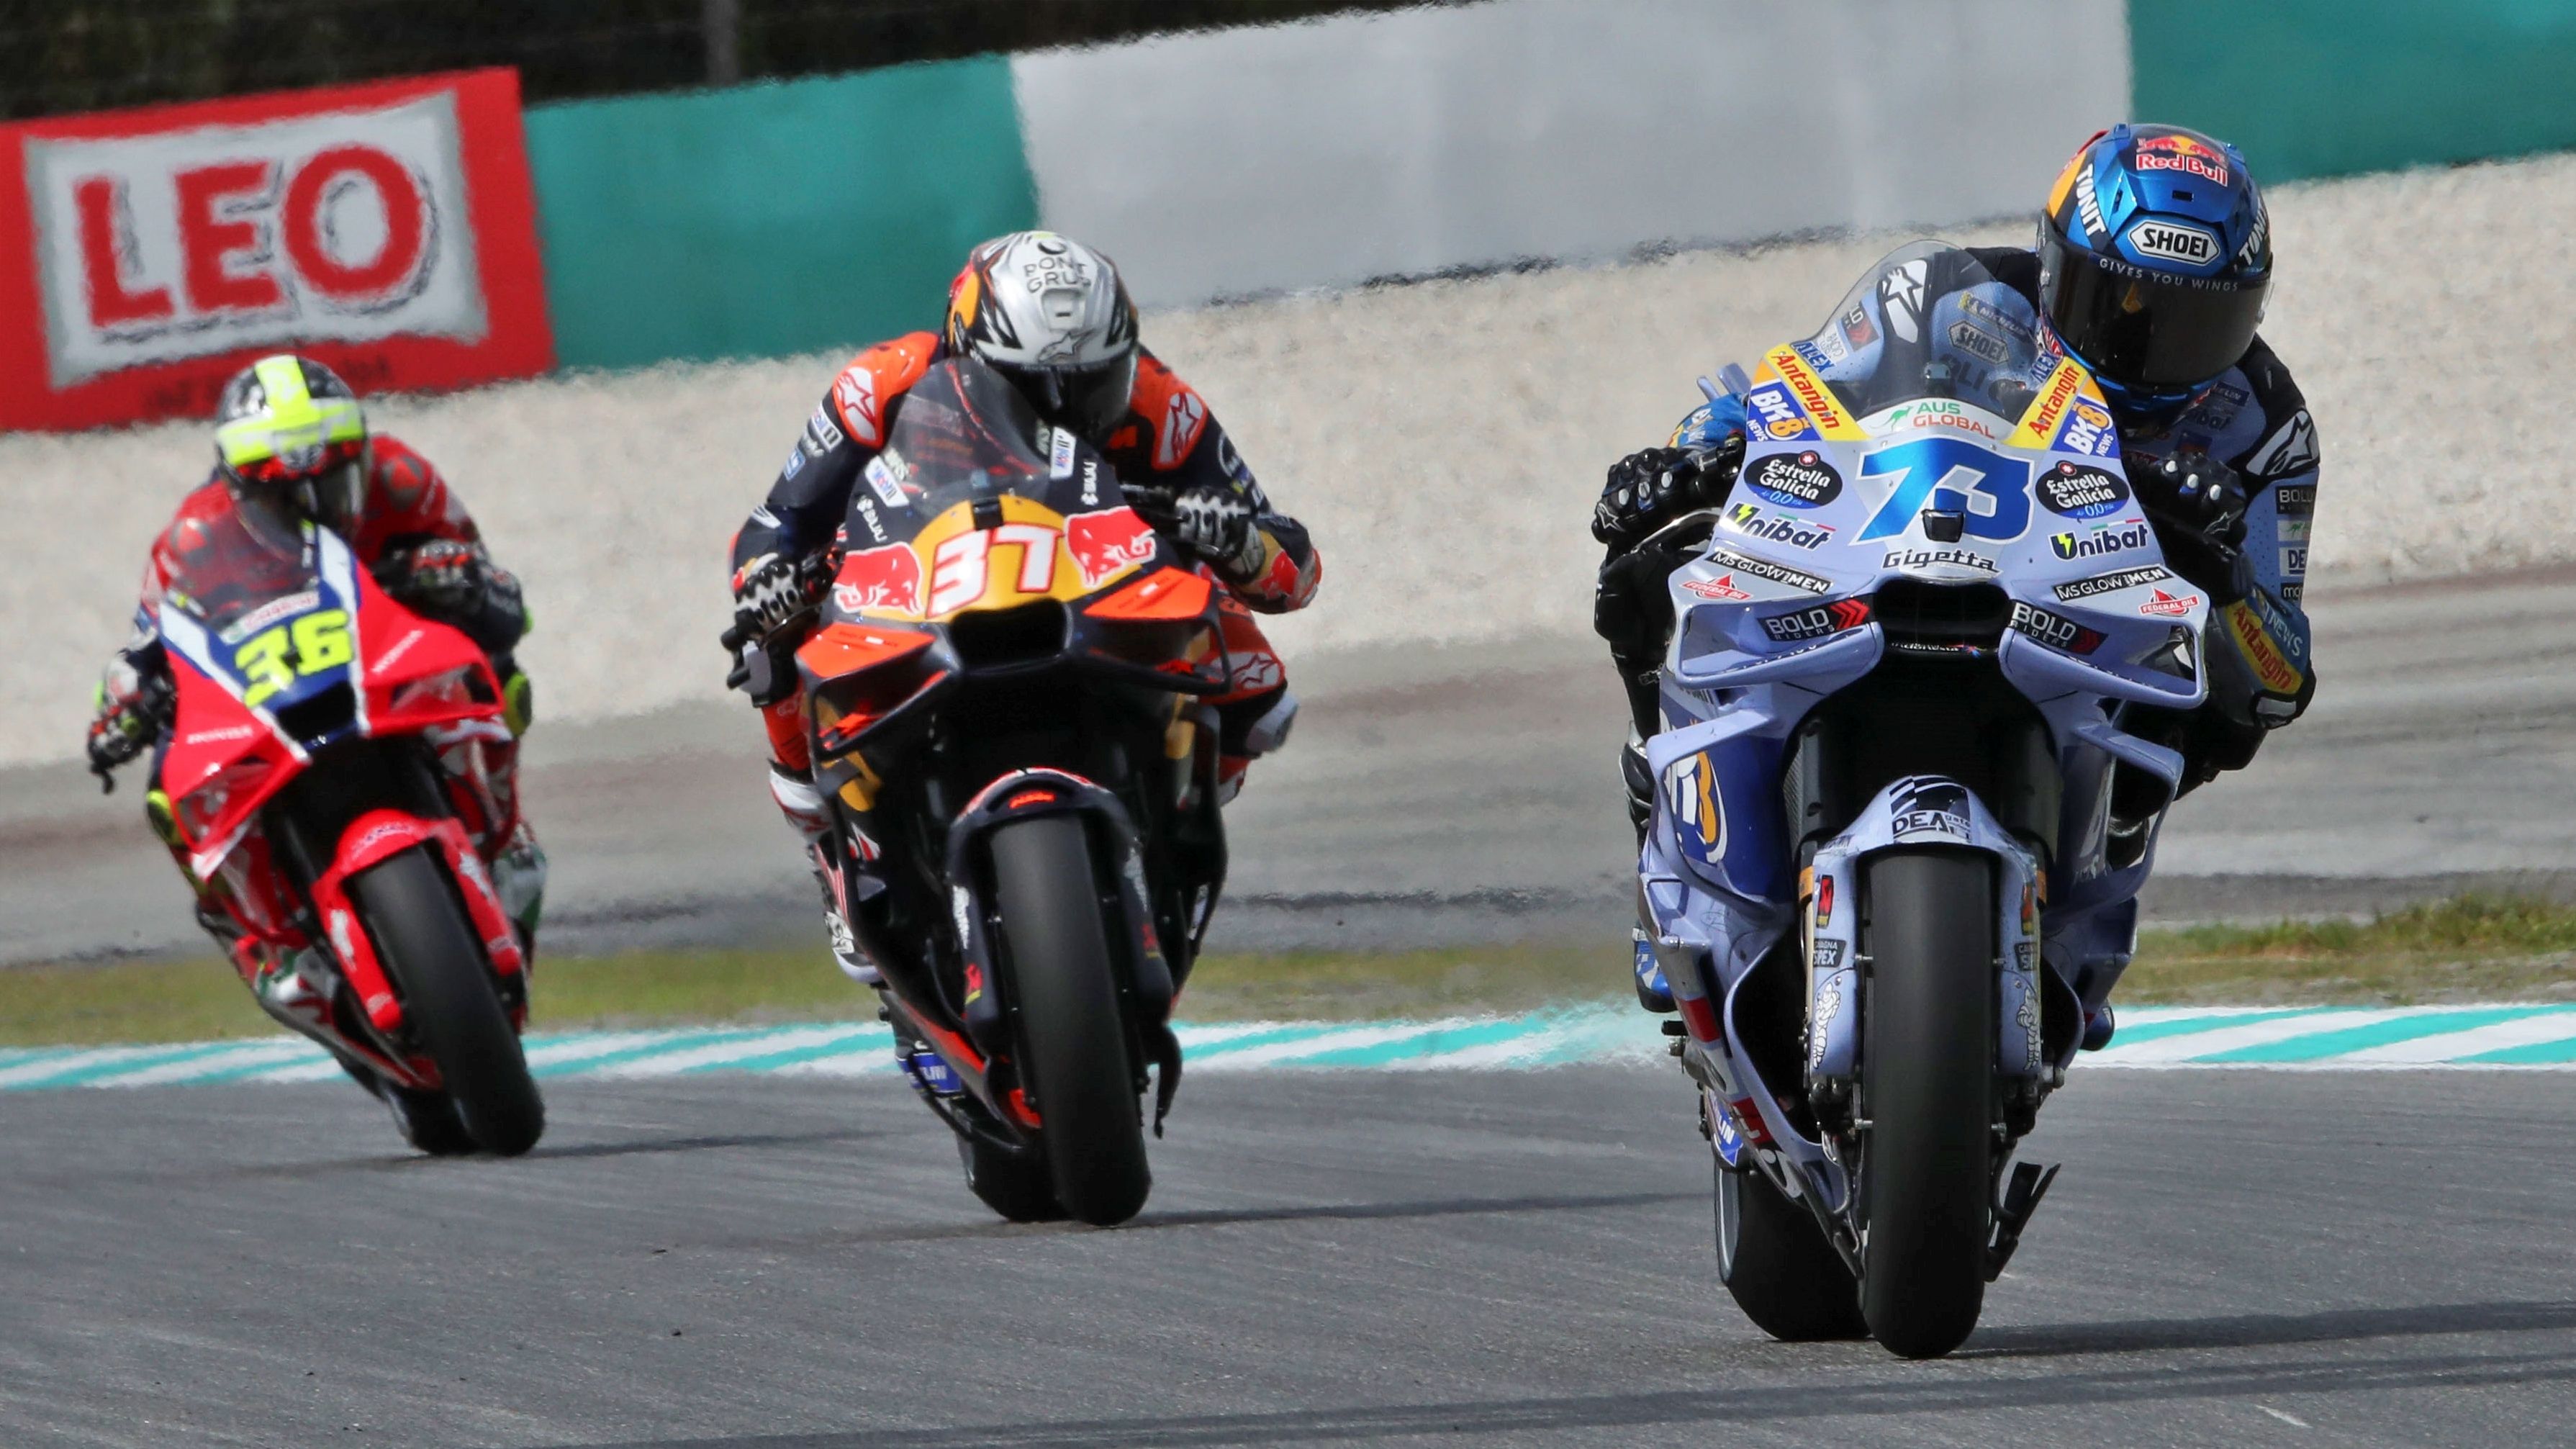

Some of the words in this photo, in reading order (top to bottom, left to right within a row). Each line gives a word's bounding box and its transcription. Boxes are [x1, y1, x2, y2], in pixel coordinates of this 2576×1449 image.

[2136, 153, 2183, 171] Red
[2186, 156, 2228, 187] Bull
[76, 145, 423, 328] LEO
[2143, 227, 2209, 258] SHOEI
[1024, 256, 1088, 278] PONT
[2100, 258, 2143, 279] GIVES
[2152, 271, 2184, 286] YOU
[2192, 279, 2239, 292] WINGS
[1792, 341, 1836, 374] ALEX
[1772, 354, 1840, 430] Antangin
[2028, 365, 2080, 440] Antangin
[1750, 389, 1805, 440] BK8
[1917, 402, 1961, 414] AUS
[1747, 419, 1768, 442] NEWS
[1913, 415, 1996, 440] GLOBAL
[2064, 404, 2110, 456] BK8
[2095, 433, 2114, 456] NEWS
[1760, 471, 1820, 500] Galicia
[1763, 459, 1832, 488] Estrella
[2046, 474, 2110, 495] Estrella
[1850, 436, 2034, 544] 73
[2056, 487, 2116, 508] Galicia
[1727, 503, 1832, 551] Unibat
[2050, 524, 2149, 560] Unibat
[926, 521, 1065, 620] 37
[1737, 557, 1785, 580] GLOW
[1883, 549, 2001, 574] Gigetta
[2287, 549, 2306, 569] DE
[2057, 584, 2081, 600] MS
[2081, 575, 2123, 594] GLOW
[2142, 601, 2179, 613] FEDERAL
[2181, 597, 2196, 607] OIL
[1766, 608, 1830, 636] BOLD
[1775, 624, 1835, 641] RIDERS
[2012, 602, 2077, 641] BOLD
[235, 608, 353, 709] 36
[1892, 812, 1949, 835] DEA
